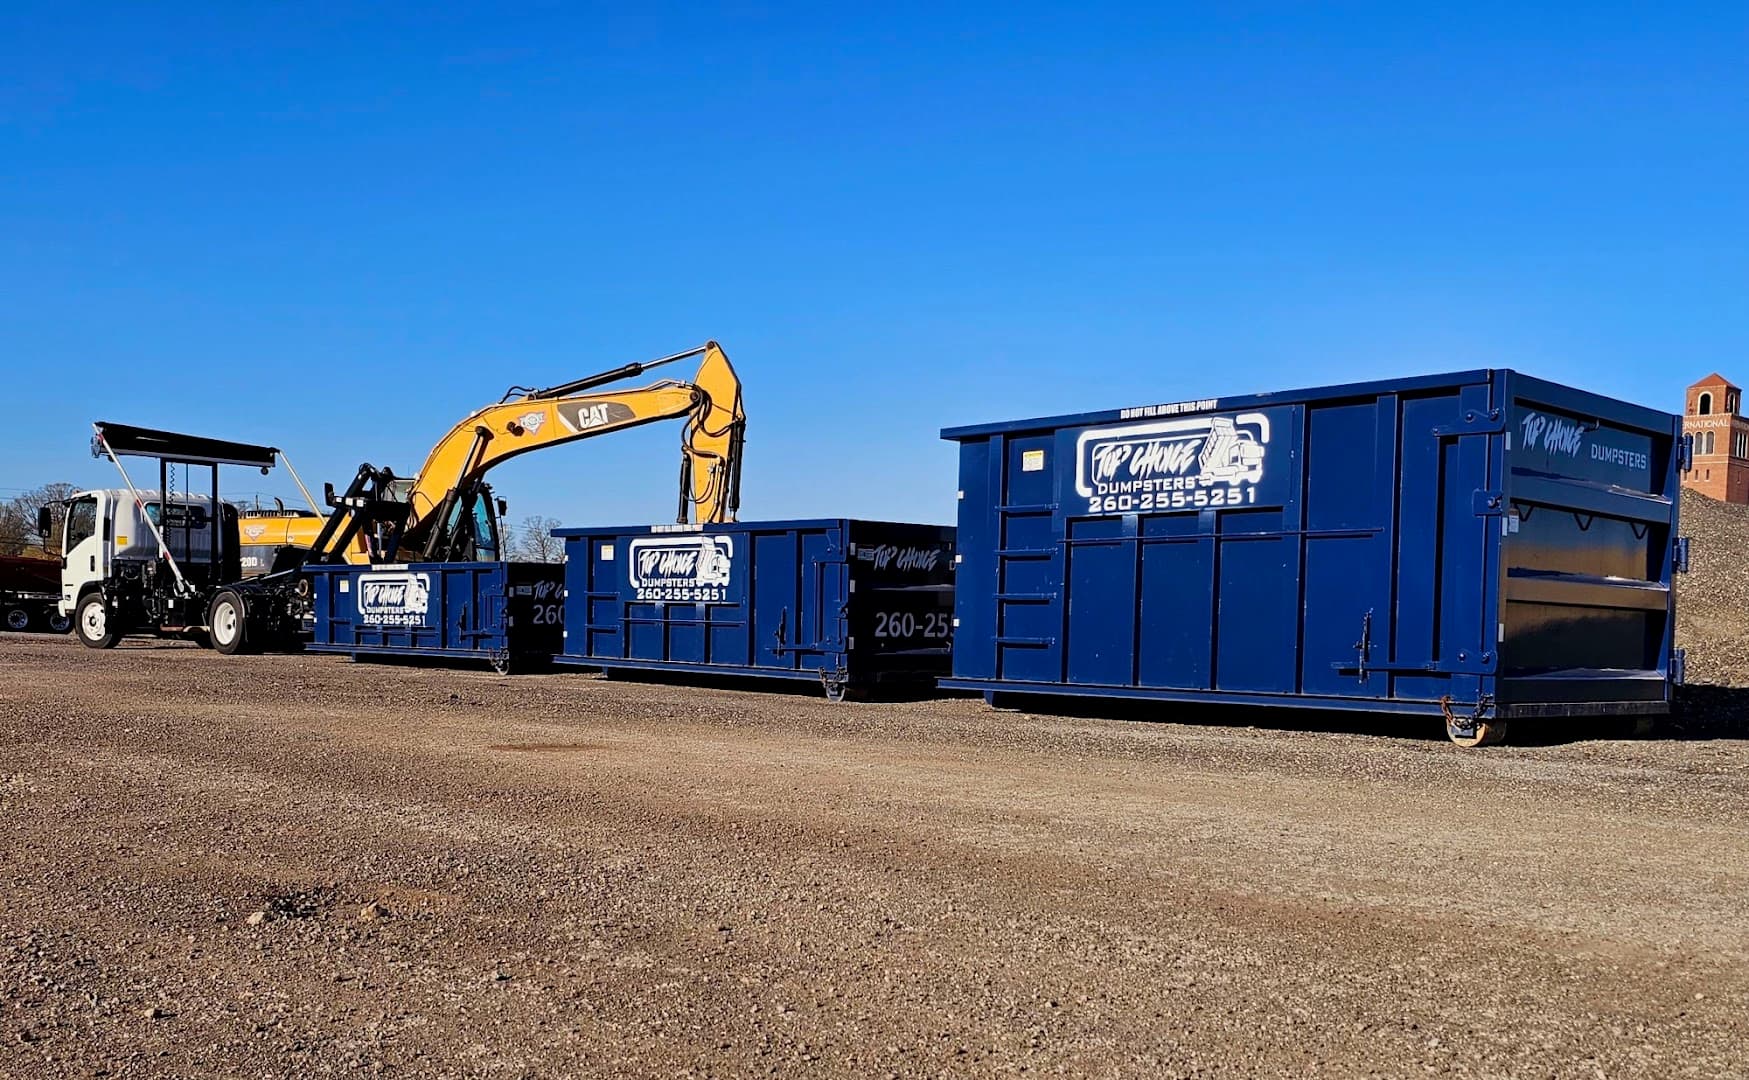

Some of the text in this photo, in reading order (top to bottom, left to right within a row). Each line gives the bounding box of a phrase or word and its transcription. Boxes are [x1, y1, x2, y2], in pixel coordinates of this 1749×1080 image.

[578, 403, 608, 429] CAT
[1120, 400, 1218, 419] DO NOT FILL ABOVE THIS POINT
[1522, 412, 1585, 459] TOP CHOICE
[1094, 440, 1201, 481] TOP CHOICE
[1591, 443, 1647, 470] DUMPSTERS
[1098, 477, 1200, 495] DUMPSTERS
[1088, 487, 1255, 512] 260-255-5251
[641, 551, 661, 576] TOP
[658, 549, 698, 578] CHOICE
[874, 544, 898, 571] TOP
[636, 588, 727, 600] 260-255-5251
[641, 578, 695, 588] DUMPSTERS
[363, 614, 426, 627] 260-255-5251
